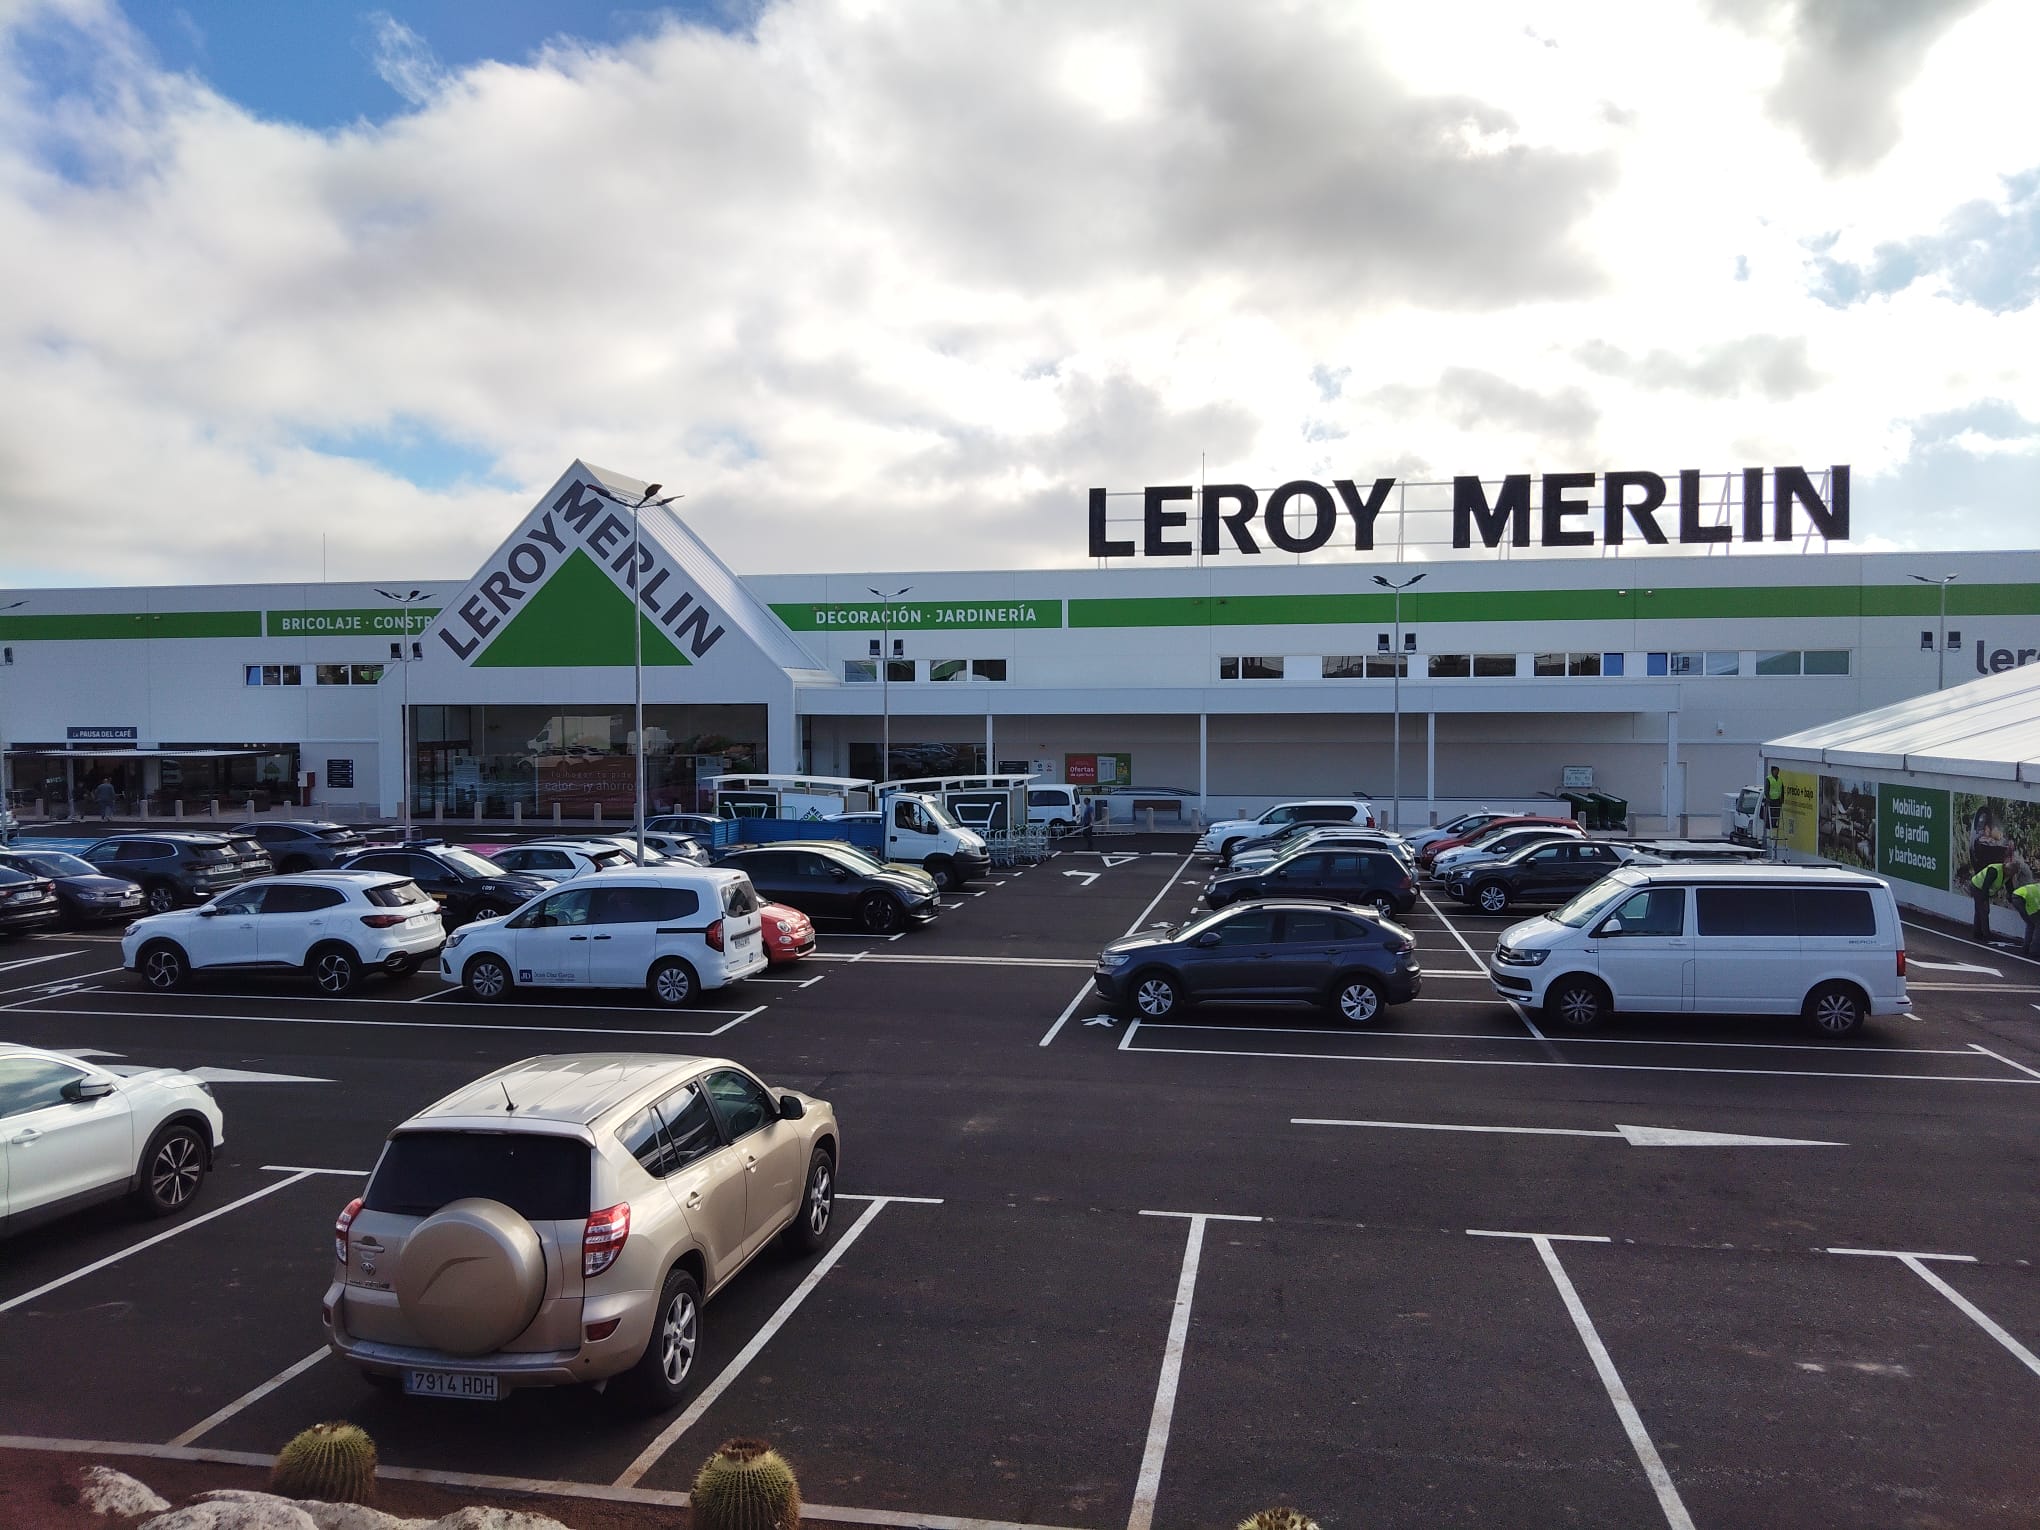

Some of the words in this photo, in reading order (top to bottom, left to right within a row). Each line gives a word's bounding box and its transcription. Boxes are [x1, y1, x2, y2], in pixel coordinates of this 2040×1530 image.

[1088, 478, 1396, 558] LEROY
[1453, 465, 1851, 549] MERLIN
[438, 511, 567, 661] LEROY
[552, 479, 726, 658] MERLIN
[282, 617, 362, 630] BRICOLAJE
[373, 616, 437, 629] CONSTR
[815, 606, 922, 624] DECORACIÓN
[935, 604, 1037, 623] JARDINERÍA
[1976, 640, 2040, 675] ler
[80, 730, 100, 738] PAUSA
[596, 780, 634, 792] ahorro
[1892, 797, 1932, 819] Mobiliario
[1895, 822, 1904, 839] de
[1905, 823, 1929, 844] jardín
[1888, 847, 1894, 864] y
[1894, 845, 1937, 871] barbacoas
[415, 1373, 456, 1392] 7914
[462, 1376, 494, 1395] HDH
